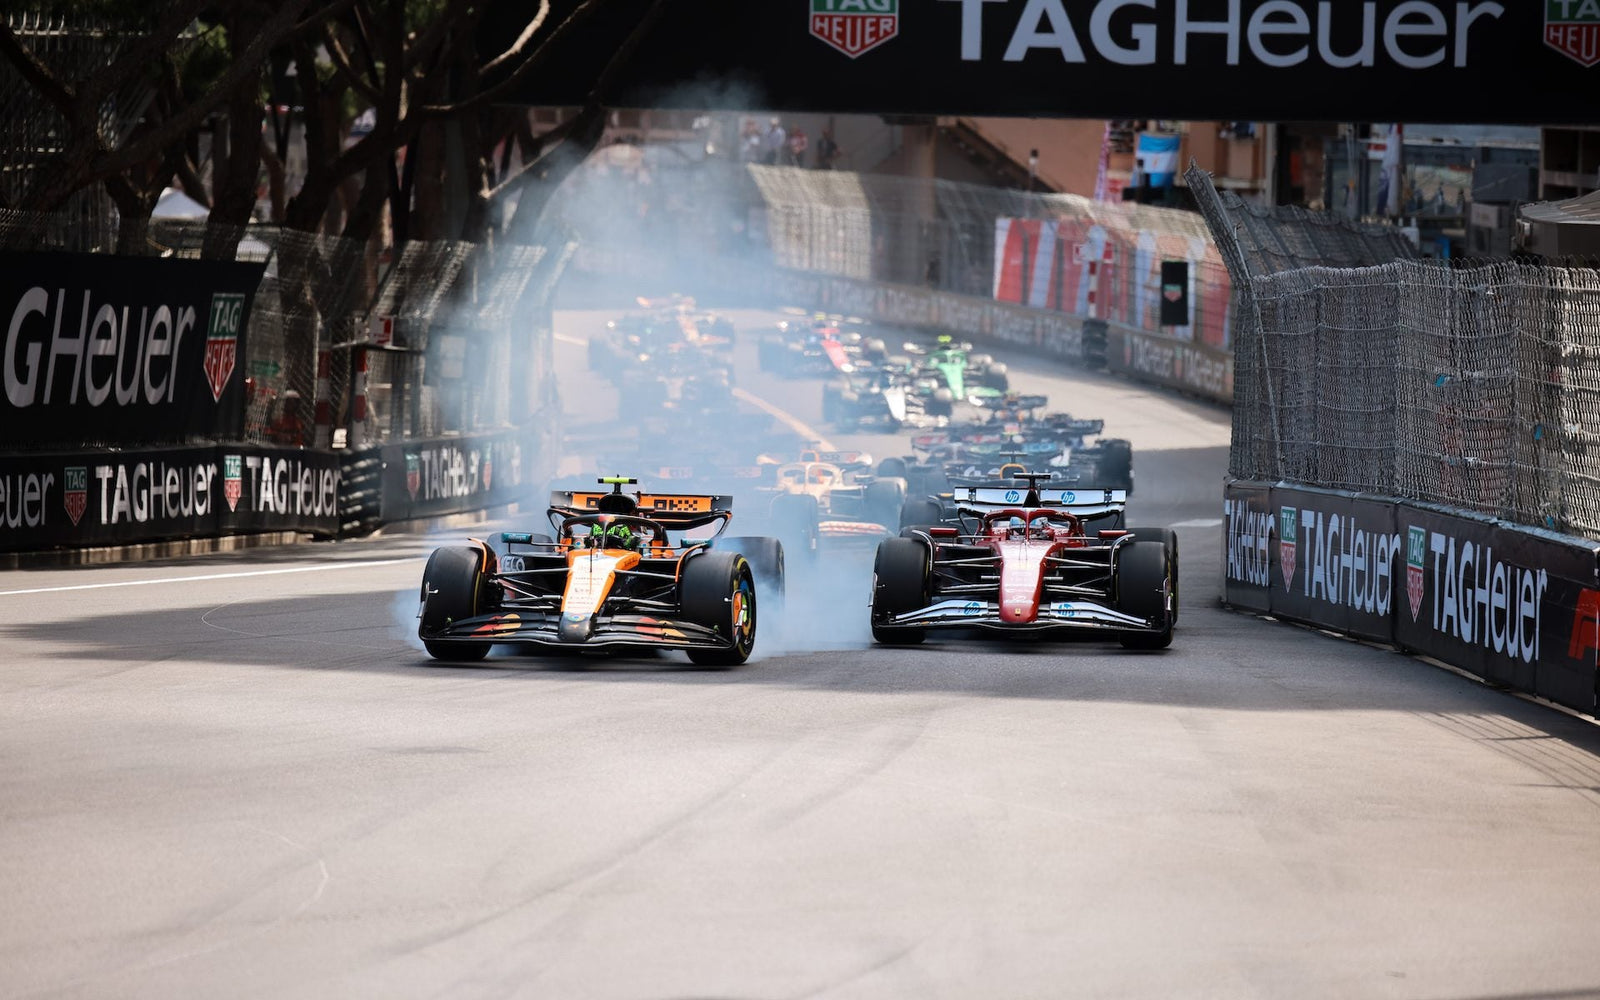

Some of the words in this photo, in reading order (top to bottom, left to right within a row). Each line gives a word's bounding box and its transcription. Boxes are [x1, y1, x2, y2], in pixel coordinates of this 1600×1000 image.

[814, 17, 893, 51] HEUER
[937, 0, 1505, 69] TAGHeuer
[214, 301, 240, 333] TAG
[4, 283, 196, 408] GHeuer
[67, 471, 86, 489] TAG
[225, 459, 241, 478] TAG
[96, 461, 218, 525] TAGHeuer
[246, 456, 343, 517] TAGHeuer
[1005, 490, 1020, 503] hp
[1061, 491, 1076, 504] hp
[654, 499, 698, 511] OKX
[1282, 513, 1296, 539] TAG
[1301, 509, 1400, 617] TAGHeuer
[1409, 532, 1424, 563] TAG
[1430, 532, 1548, 664] TAGHeuer
